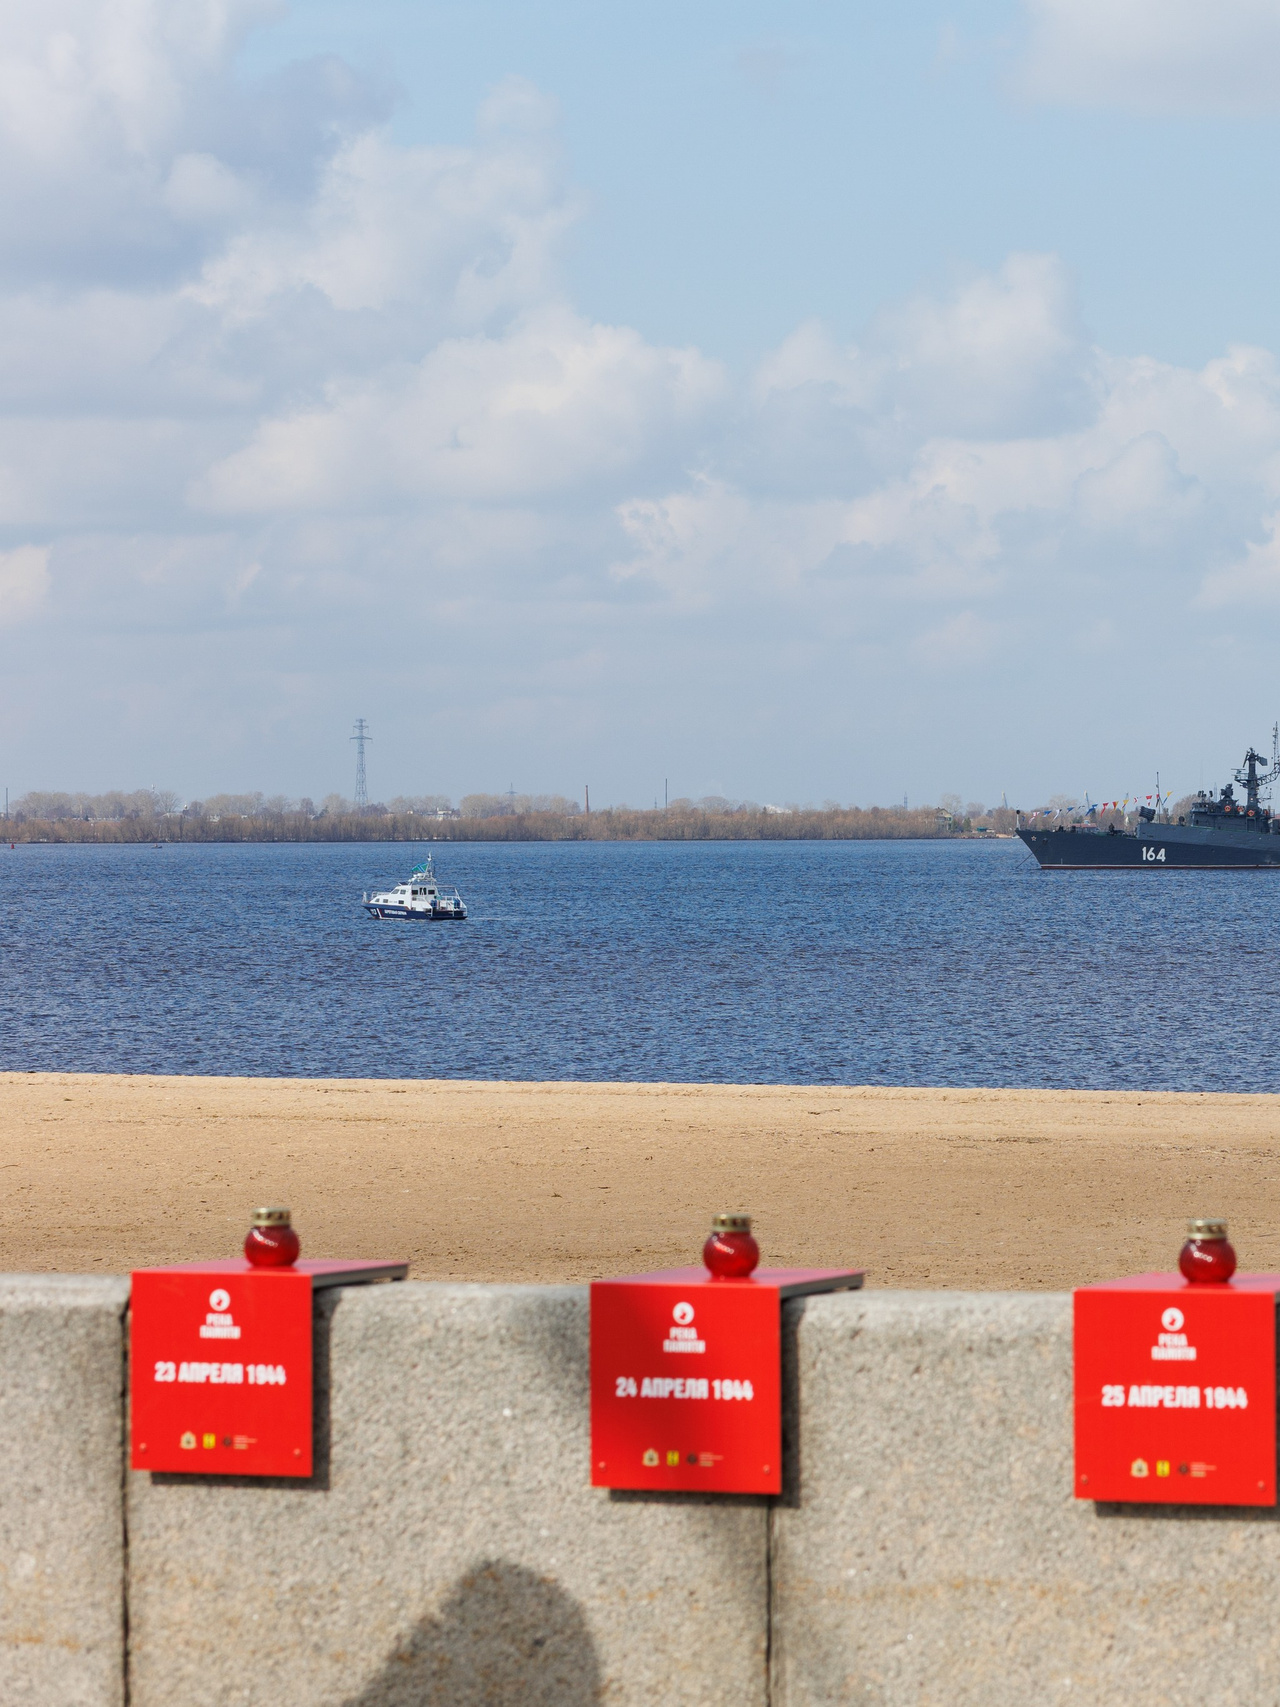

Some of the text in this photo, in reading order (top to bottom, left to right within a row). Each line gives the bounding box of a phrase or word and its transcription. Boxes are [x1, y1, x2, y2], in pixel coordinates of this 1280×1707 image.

[1142, 846, 1166, 862] 164
[154, 1361, 287, 1385] 23 АПРЕЛЯ 1944
[615, 1376, 754, 1401] 24 АПРЕЛЯ 1944
[1101, 1385, 1248, 1409] 25 АПРЕЛЯ 1944
